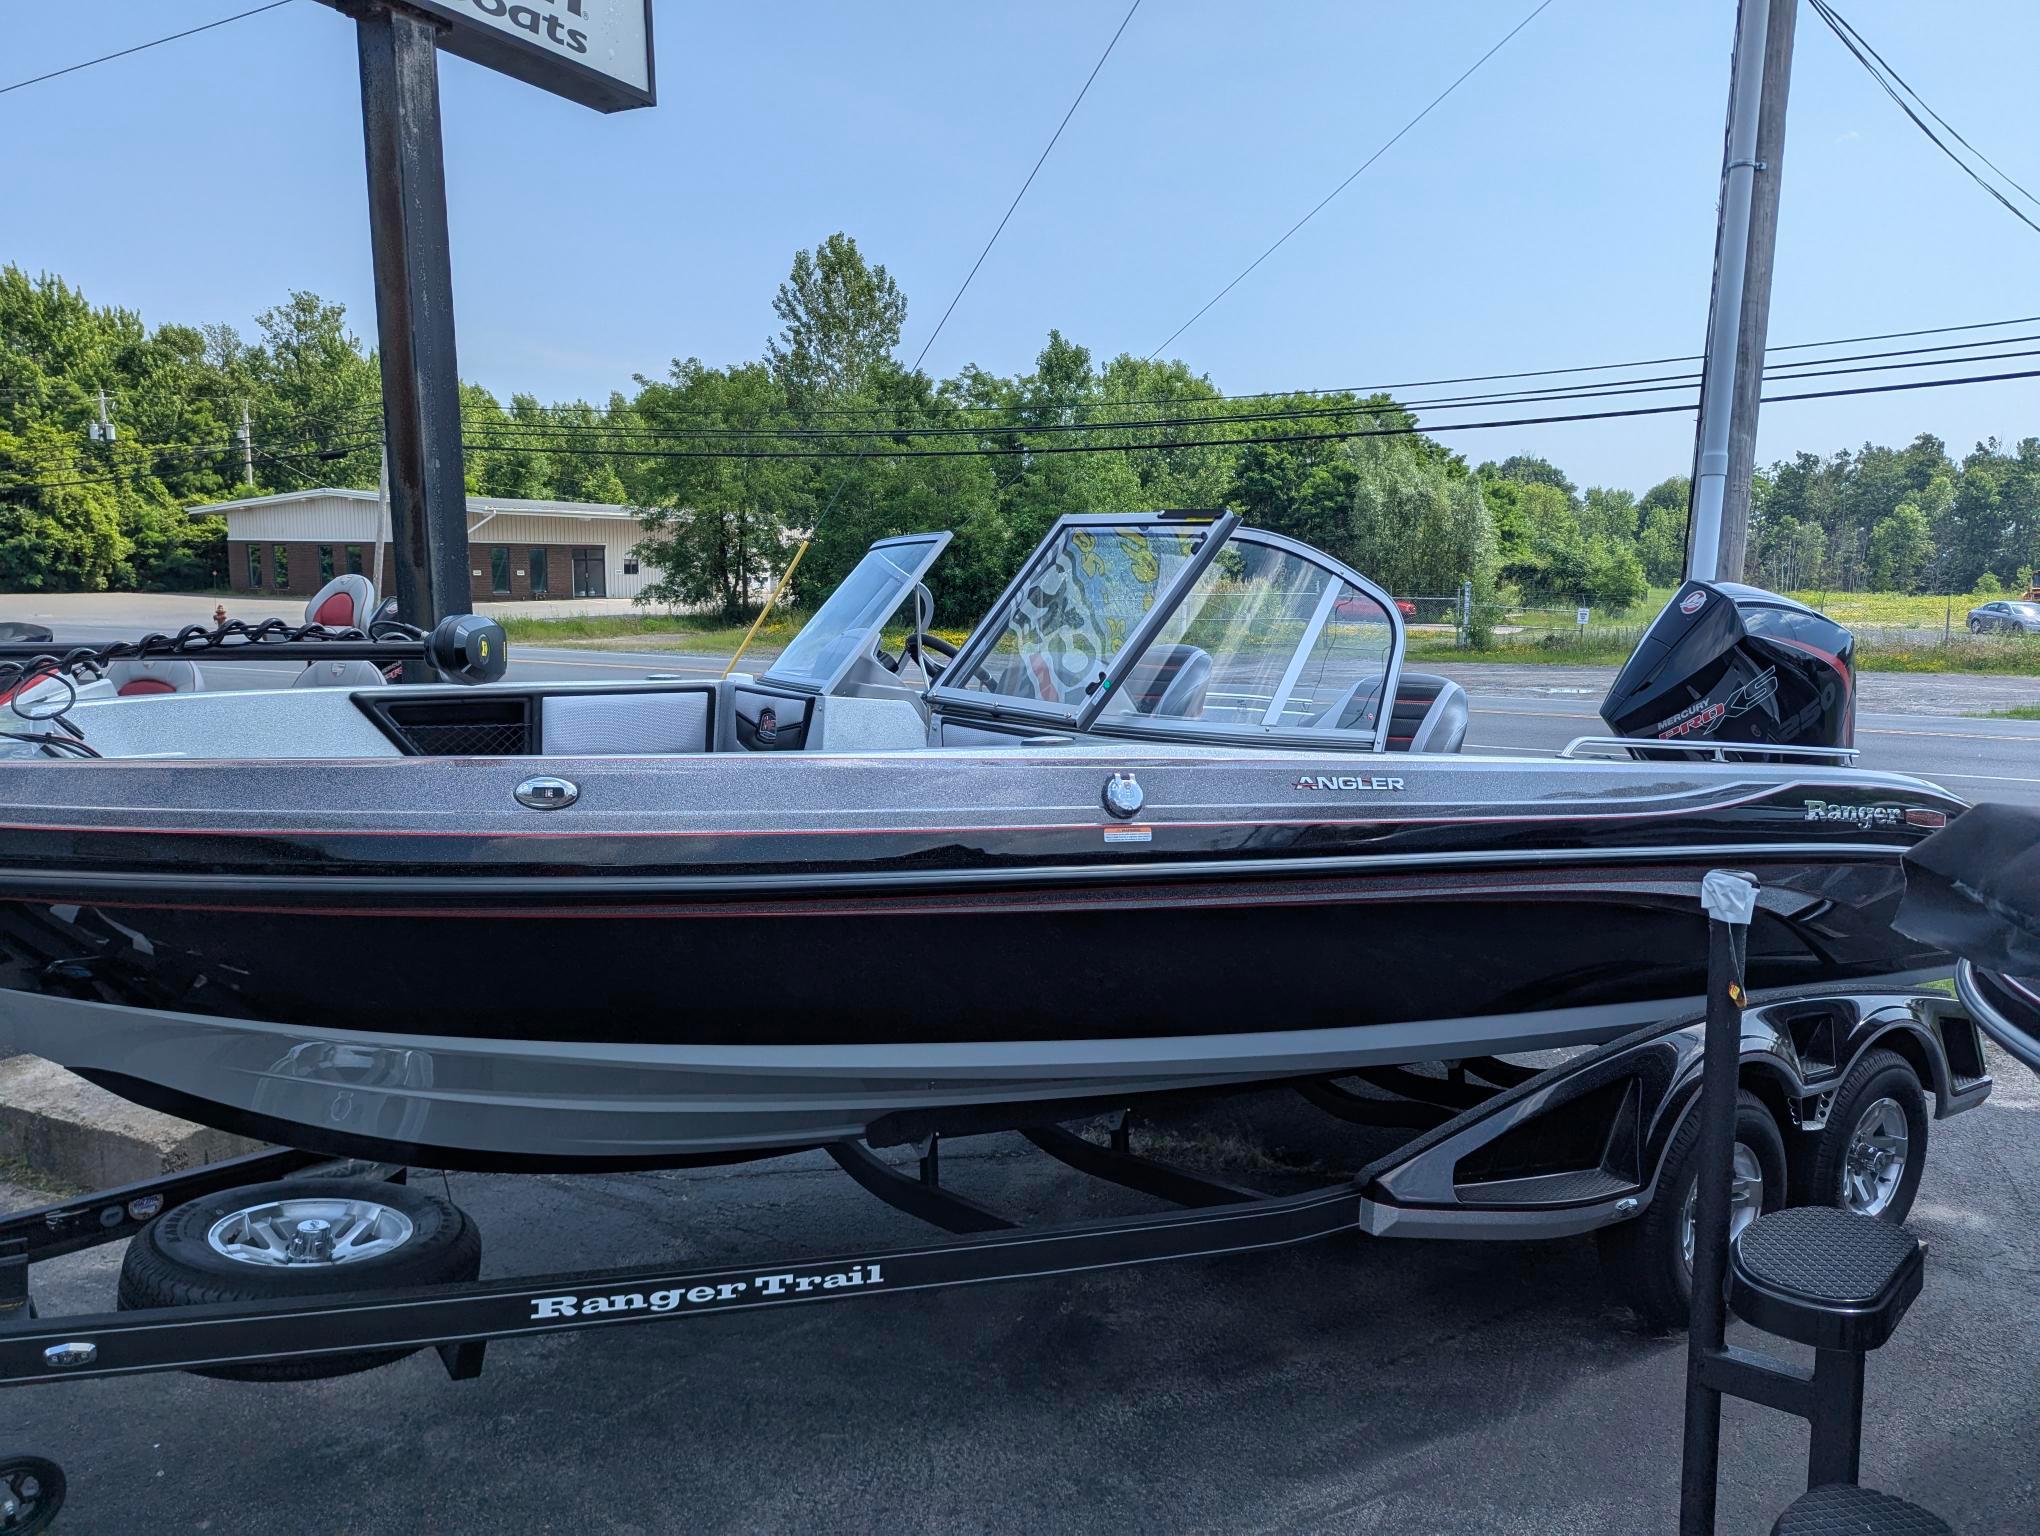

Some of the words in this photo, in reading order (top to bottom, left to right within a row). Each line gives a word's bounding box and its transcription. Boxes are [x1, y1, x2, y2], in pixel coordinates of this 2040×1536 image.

[456, 0, 588, 54] oats
[1657, 697, 1711, 730] MERCURY
[1658, 702, 1725, 740] PRO
[1294, 776, 1406, 791] ANGLER
[1804, 799, 1901, 830] Ranger
[530, 1281, 747, 1320] Ranger
[755, 1264, 885, 1296] Trail
